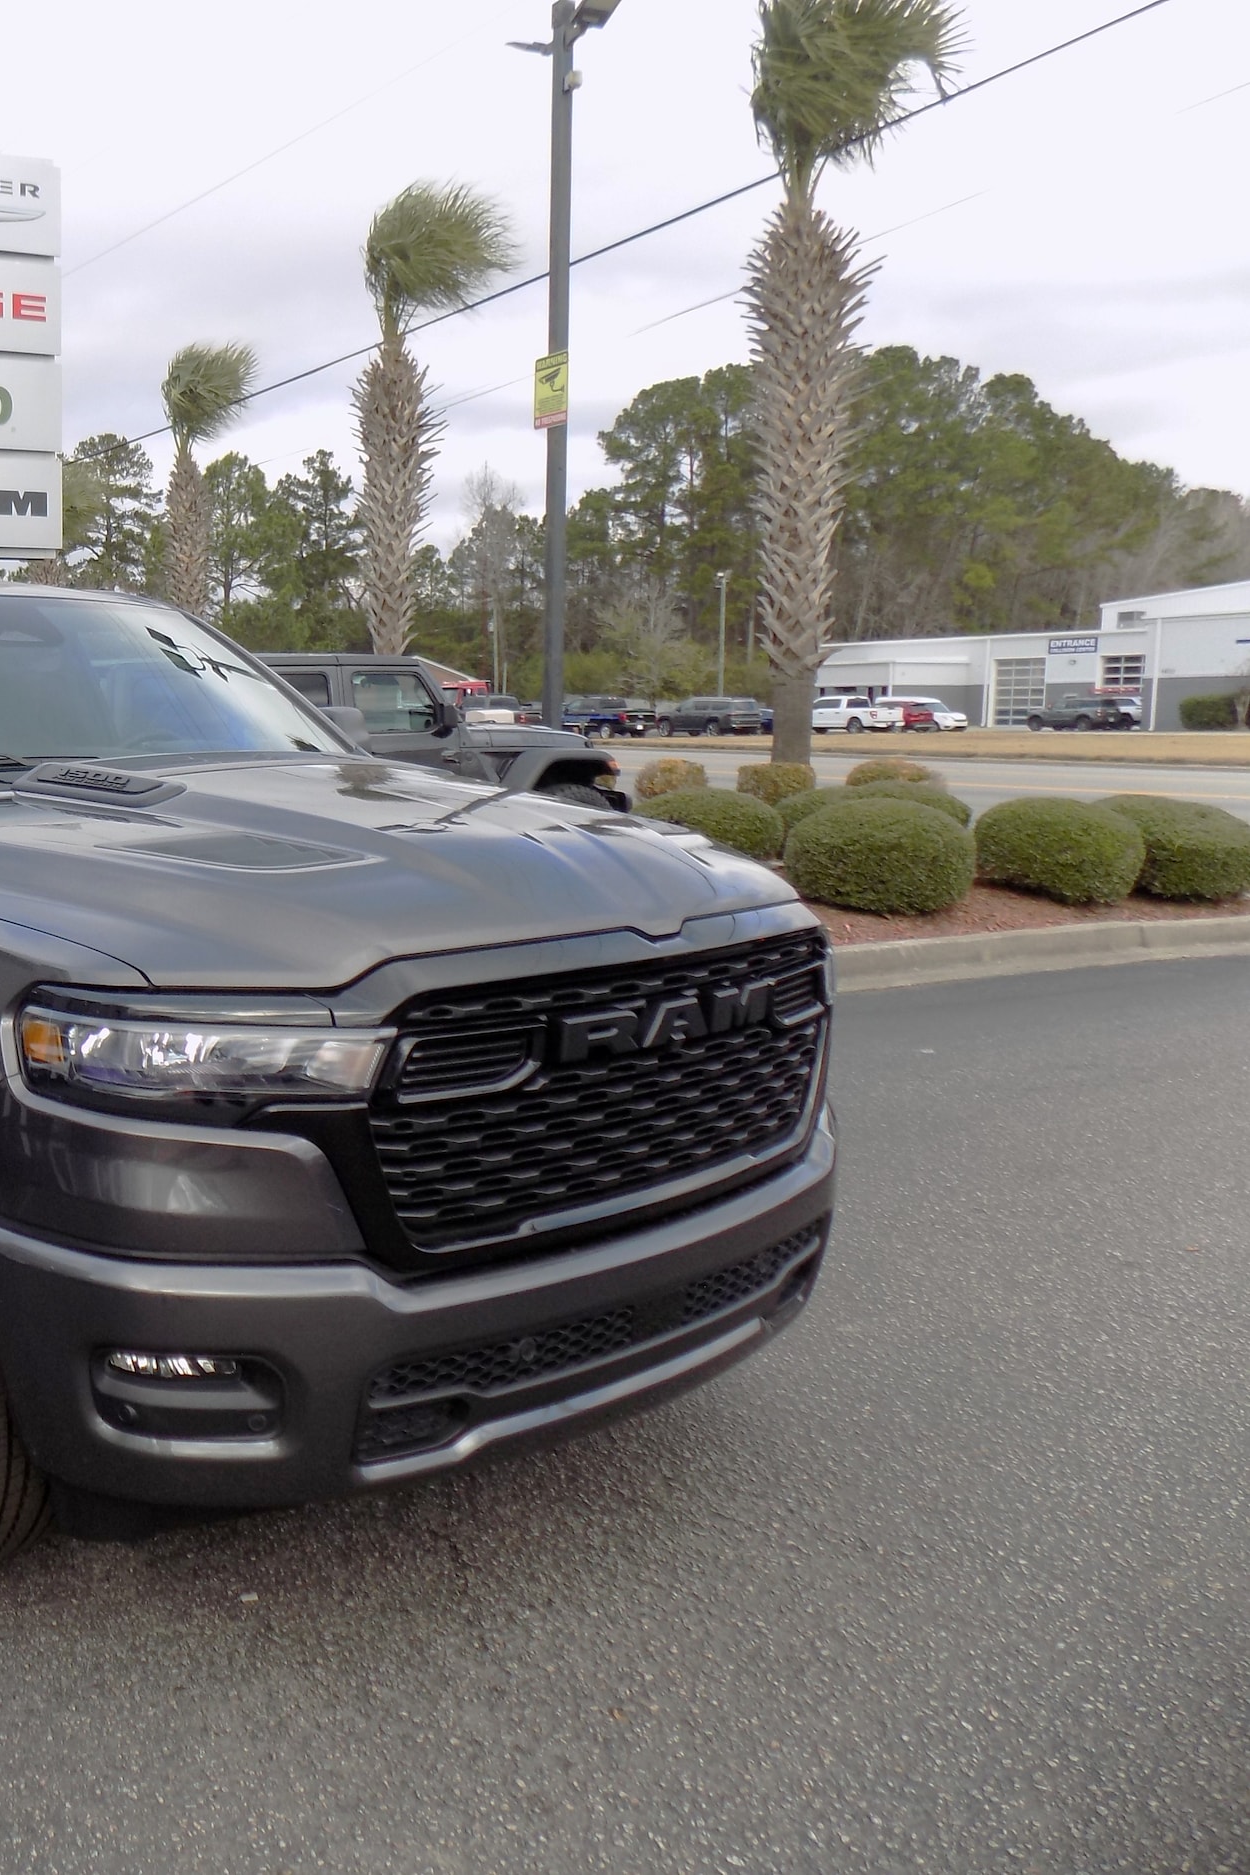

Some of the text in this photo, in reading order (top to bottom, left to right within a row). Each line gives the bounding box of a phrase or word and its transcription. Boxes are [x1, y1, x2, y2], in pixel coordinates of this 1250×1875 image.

[1050, 638, 1097, 648] ENTRANCE
[58, 769, 131, 786] 1500
[560, 977, 777, 1063] RAM
